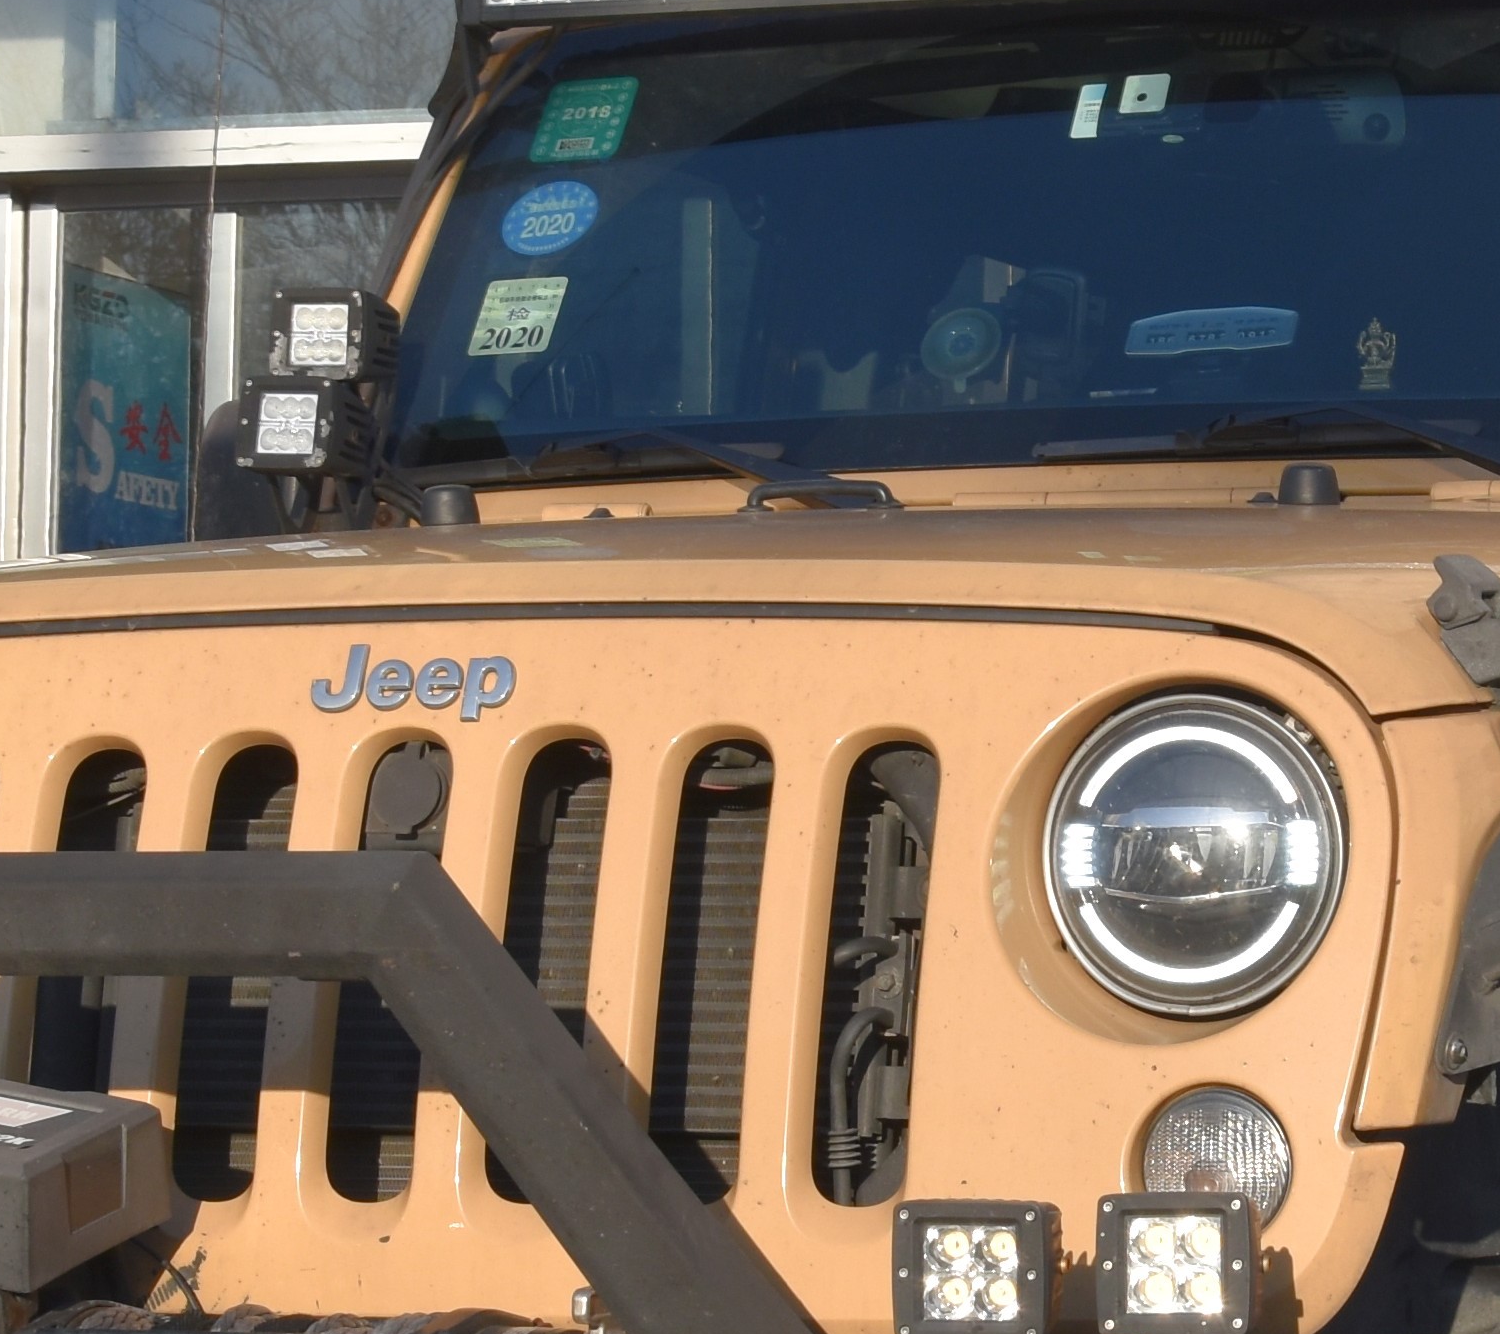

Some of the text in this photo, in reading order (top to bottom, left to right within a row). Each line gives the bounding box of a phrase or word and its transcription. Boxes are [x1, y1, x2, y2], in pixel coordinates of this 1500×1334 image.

[520, 212, 576, 239] 2020
[479, 325, 544, 350] 2020
[310, 643, 517, 722] Jeep
